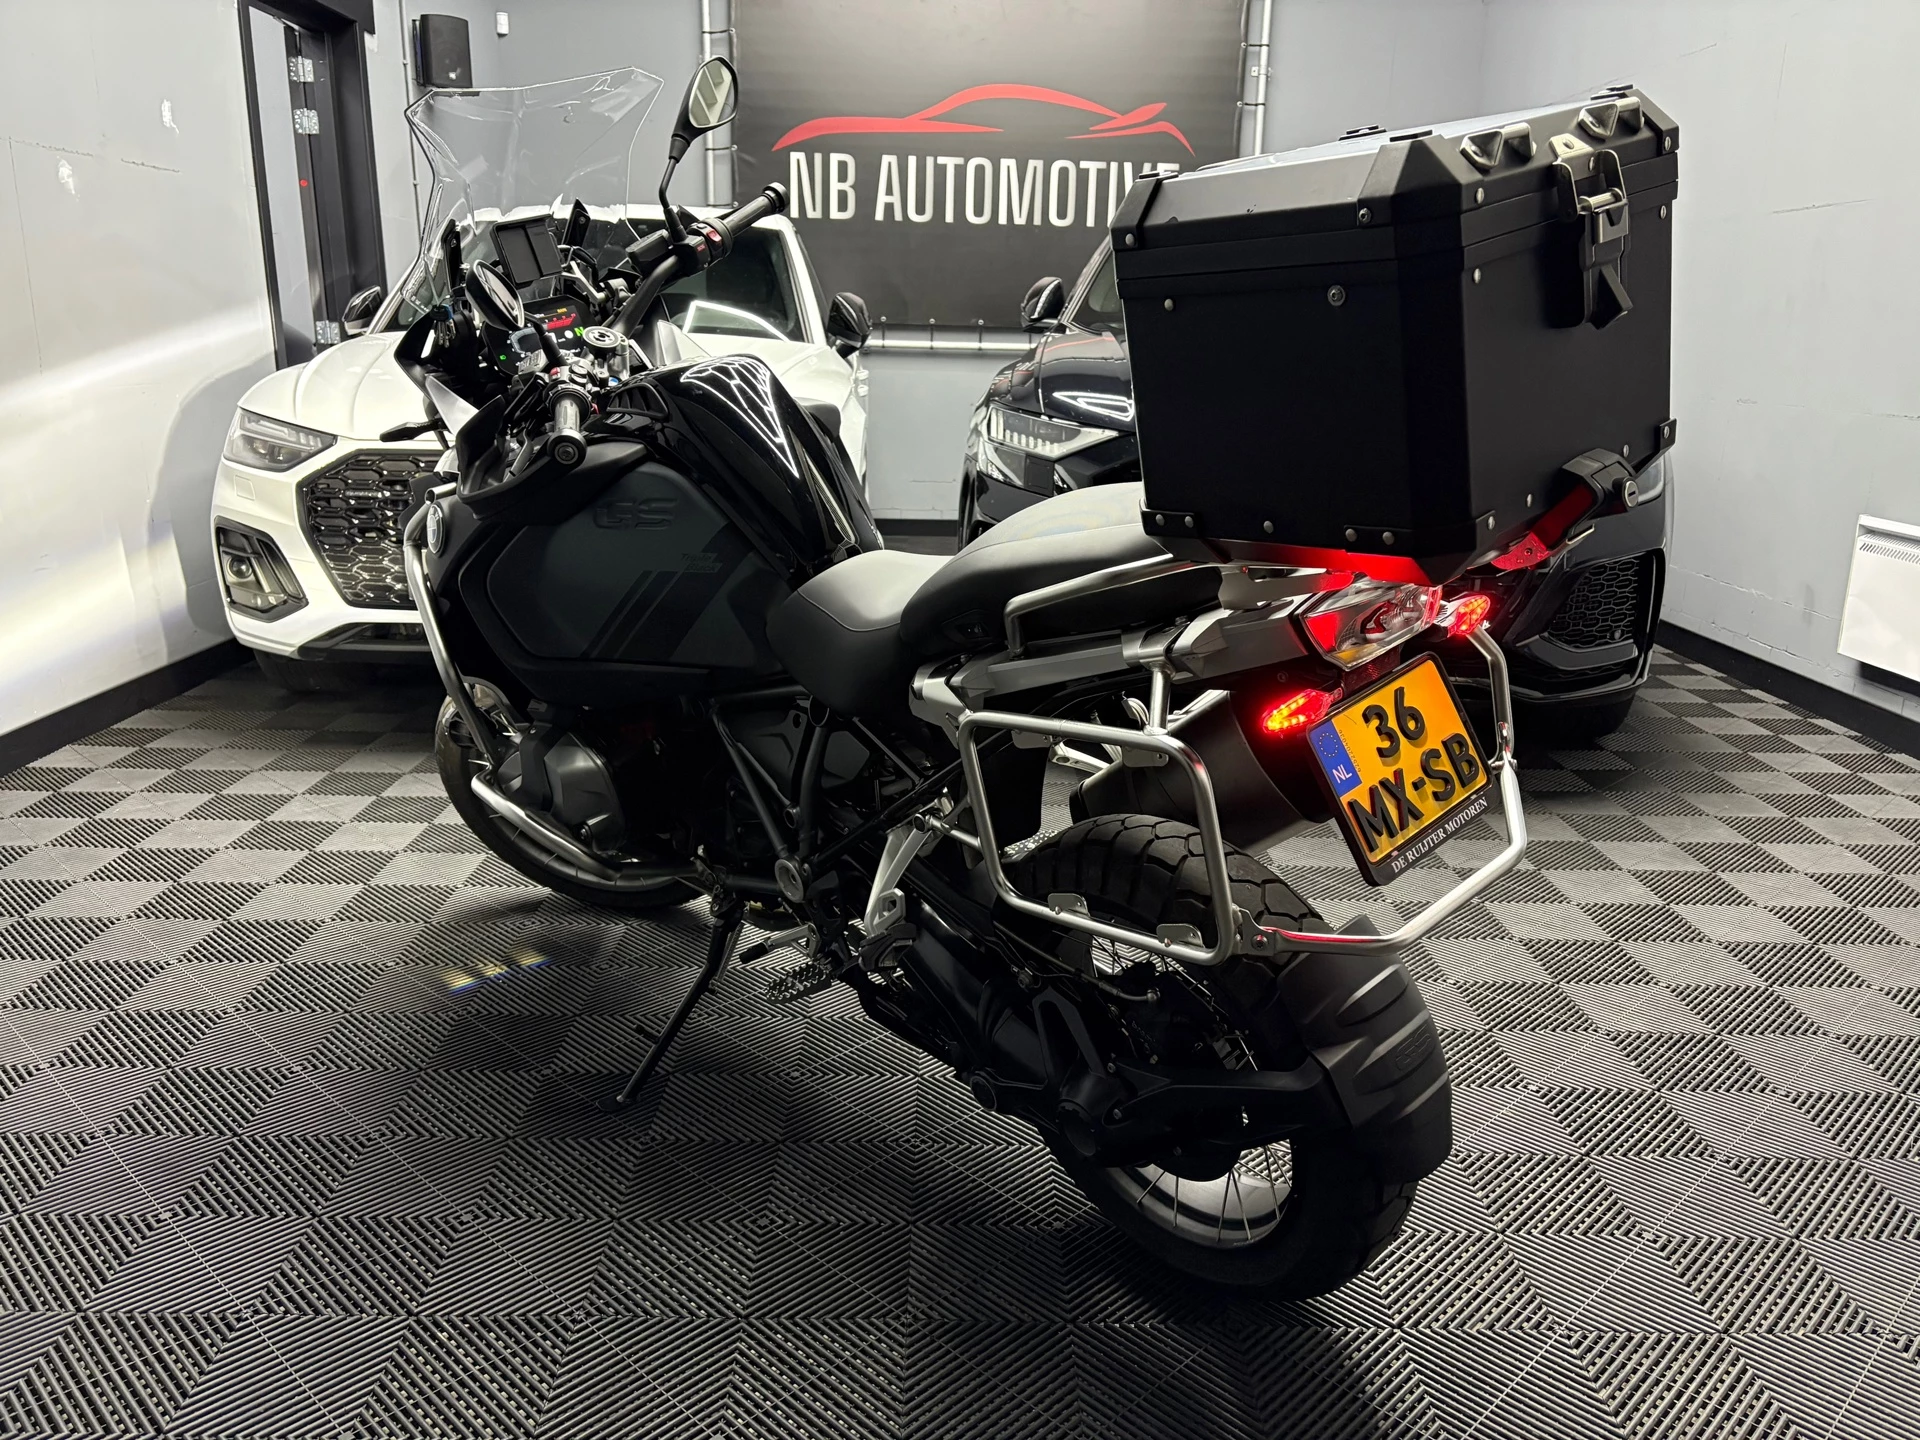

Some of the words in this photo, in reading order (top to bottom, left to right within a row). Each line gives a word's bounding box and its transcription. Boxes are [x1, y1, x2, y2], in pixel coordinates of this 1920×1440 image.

[789, 151, 857, 221] NB
[592, 497, 679, 531] GS
[1361, 686, 1426, 759] 36
[1333, 764, 1353, 784] NL
[1347, 732, 1480, 853] MX-SB
[1390, 854, 1408, 874] DE
[1407, 828, 1447, 863] RUIJTER
[1445, 796, 1489, 837] MOTOREN
